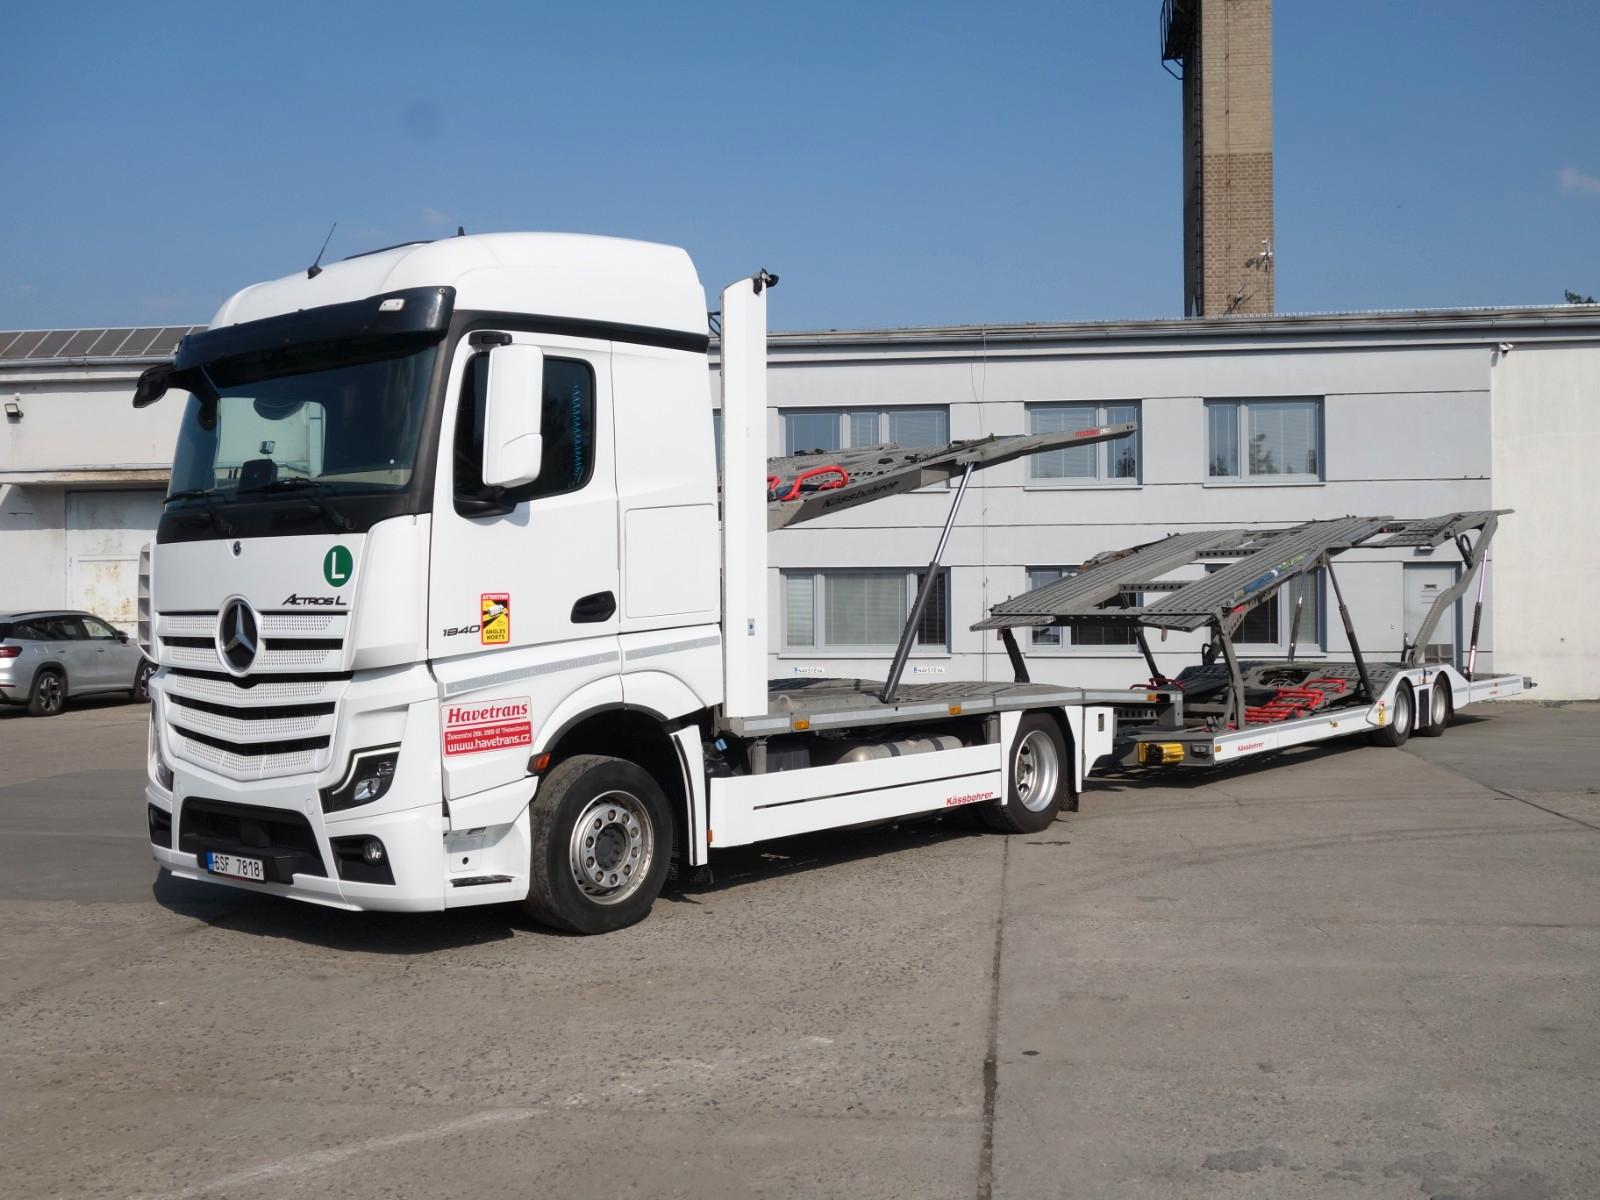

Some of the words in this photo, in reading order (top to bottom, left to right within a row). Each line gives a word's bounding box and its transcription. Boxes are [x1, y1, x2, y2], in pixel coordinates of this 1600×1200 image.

[331, 551, 345, 579] L
[335, 595, 347, 606] L
[443, 625, 480, 637] 1840
[448, 703, 528, 724] Havetrans
[447, 734, 530, 752] www.havetrans.cz
[215, 855, 229, 873] 6SF
[236, 858, 260, 877] 7818
